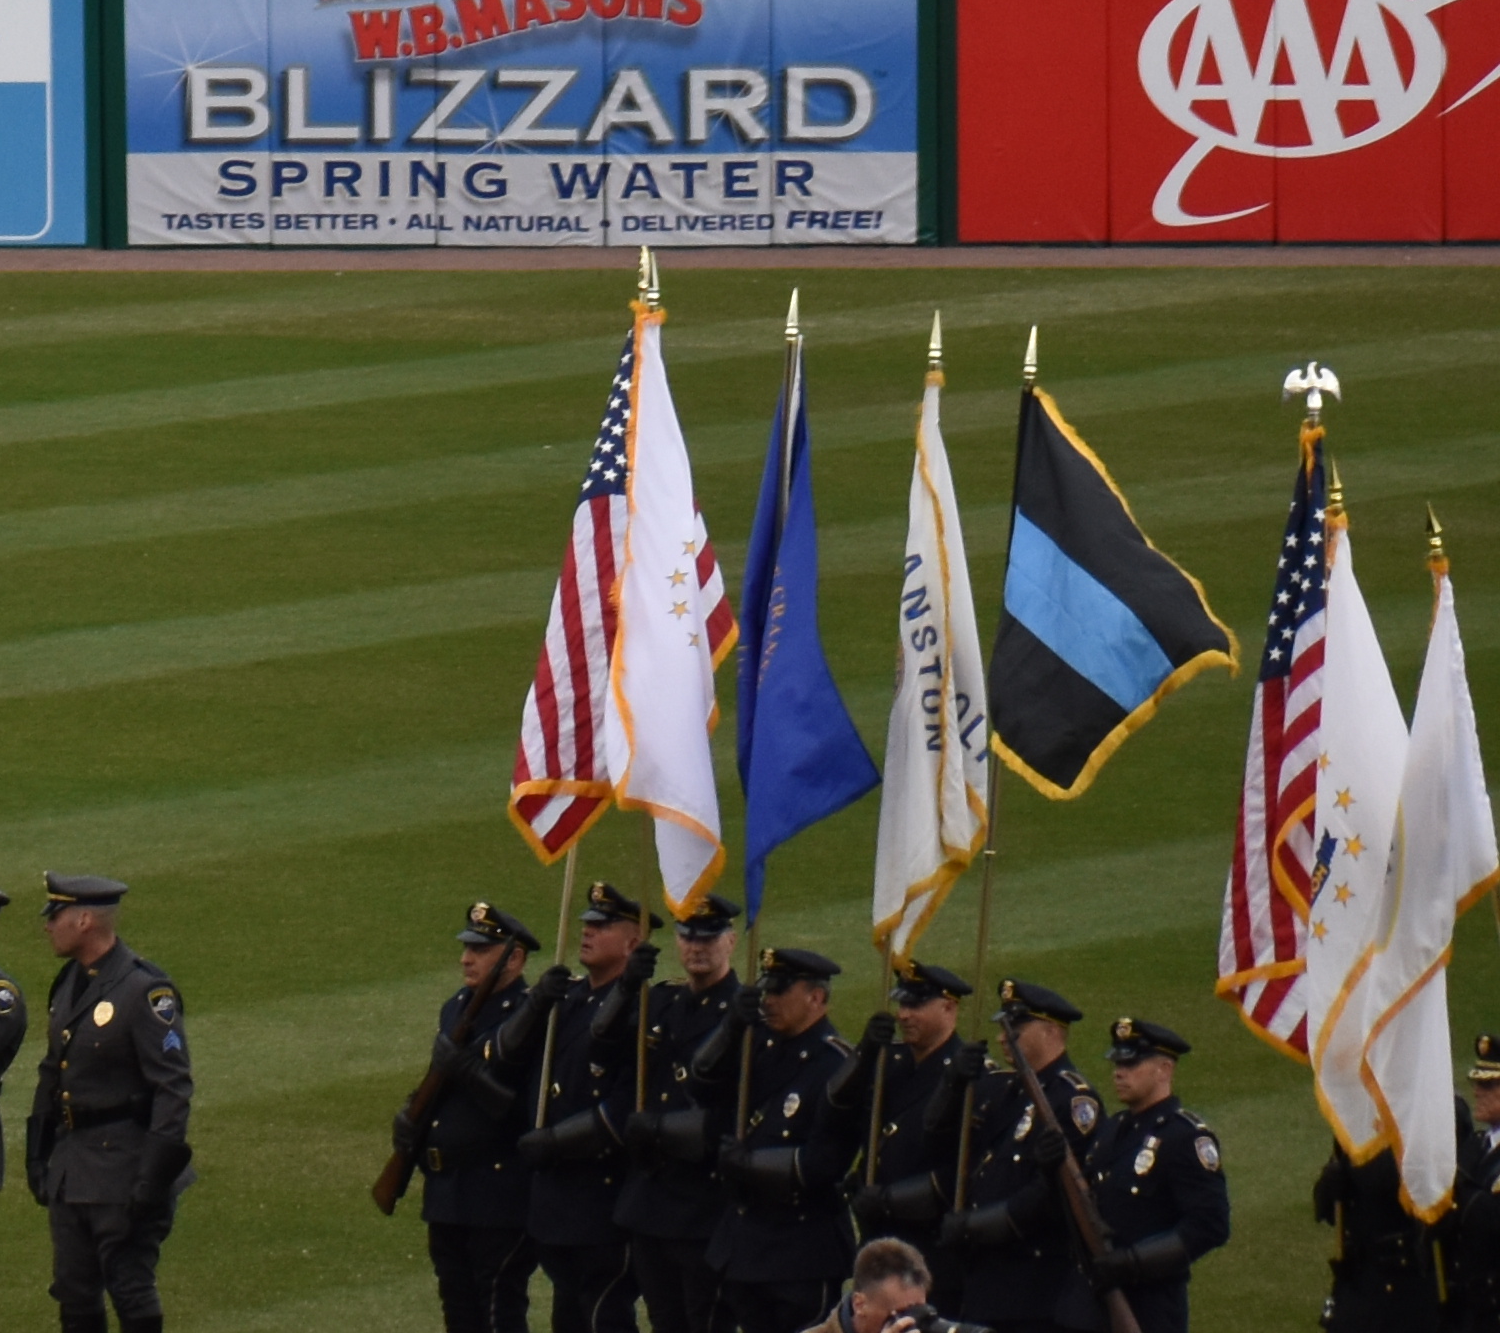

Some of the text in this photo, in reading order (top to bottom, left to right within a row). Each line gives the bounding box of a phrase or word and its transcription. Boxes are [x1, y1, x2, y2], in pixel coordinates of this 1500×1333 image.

[187, 66, 874, 142] BLIZZARD
[217, 159, 816, 200] SPRING WATER
[162, 210, 885, 231] TASTES BETTER ALL NATURAL DELIVERED FREE!
